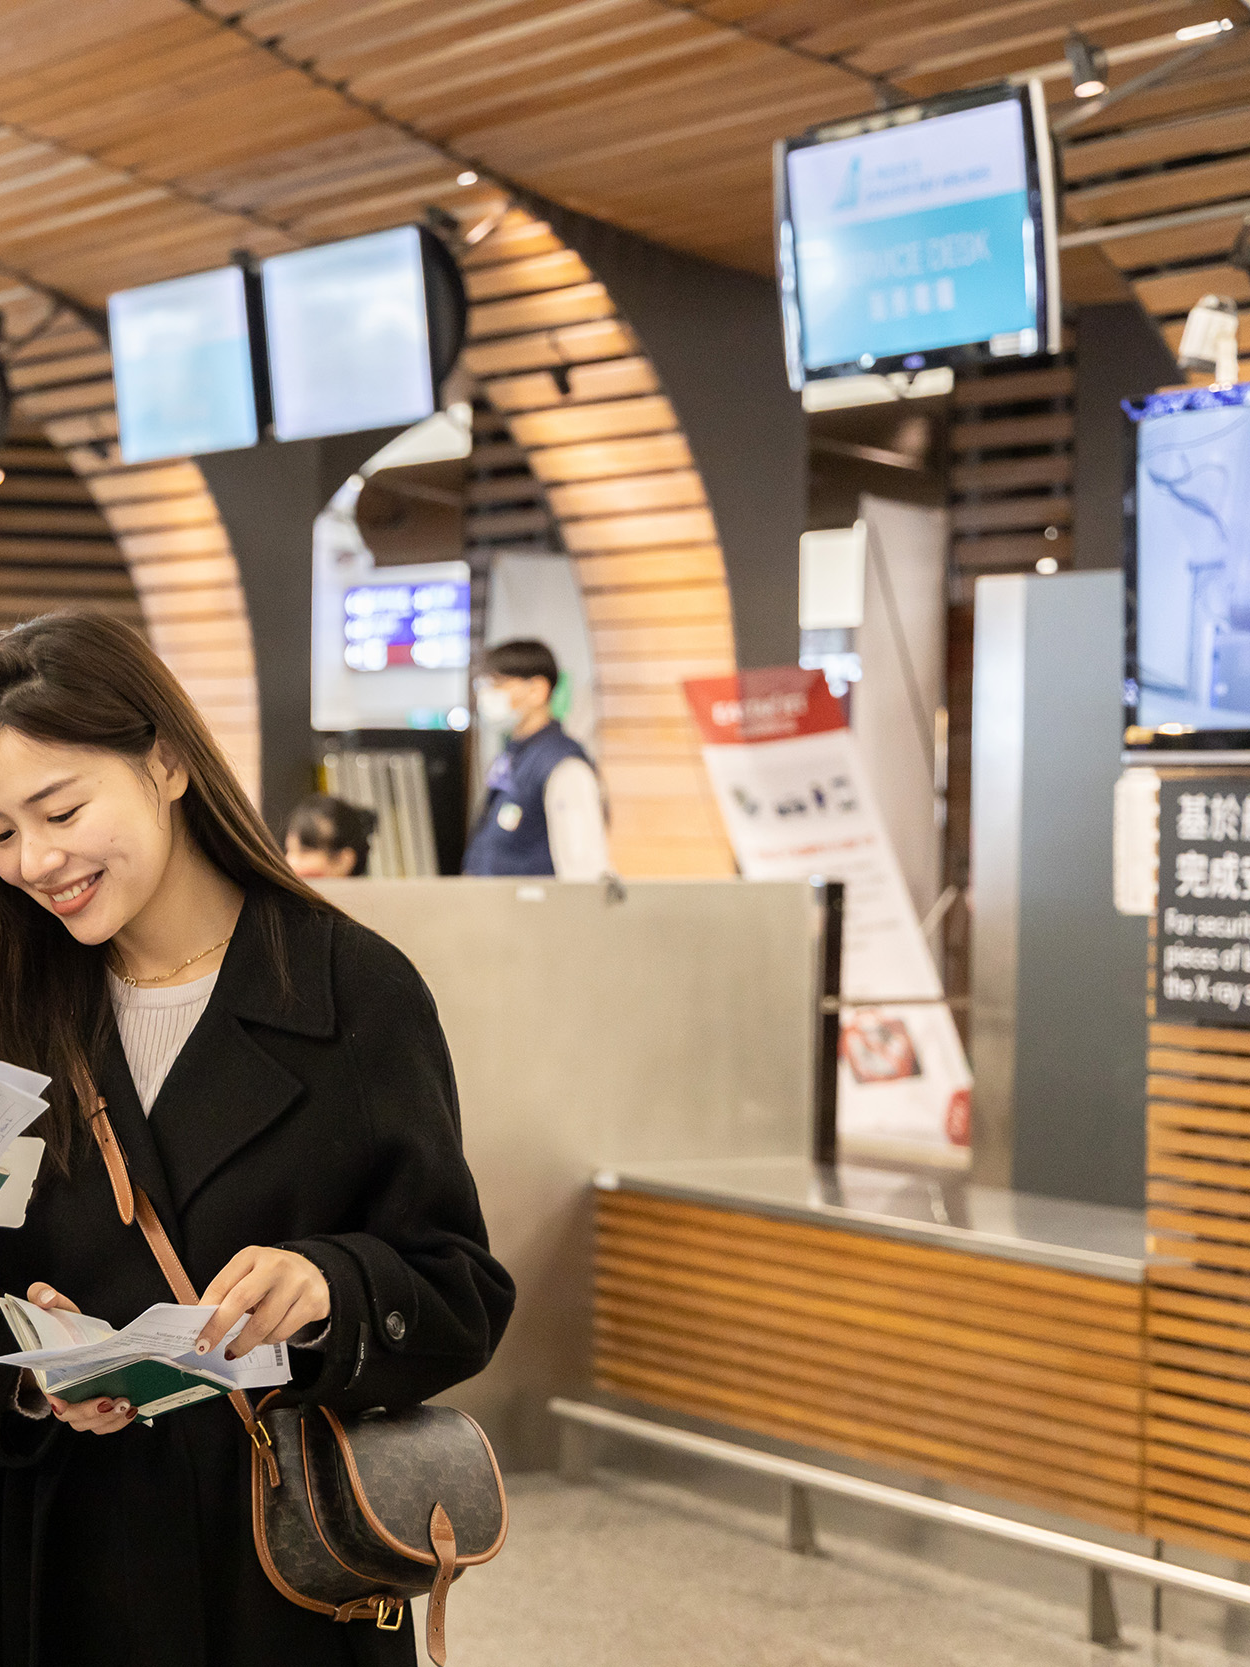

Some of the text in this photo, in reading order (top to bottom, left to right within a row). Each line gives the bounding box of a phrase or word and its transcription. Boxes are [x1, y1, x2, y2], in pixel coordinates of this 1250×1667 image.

[1176, 792, 1250, 842] 基於
[1164, 907, 1195, 936] For
[1163, 940, 1219, 973] pieces
[1220, 943, 1240, 972] of
[1163, 970, 1195, 1001] the
[1194, 974, 1242, 1011] X-ray
